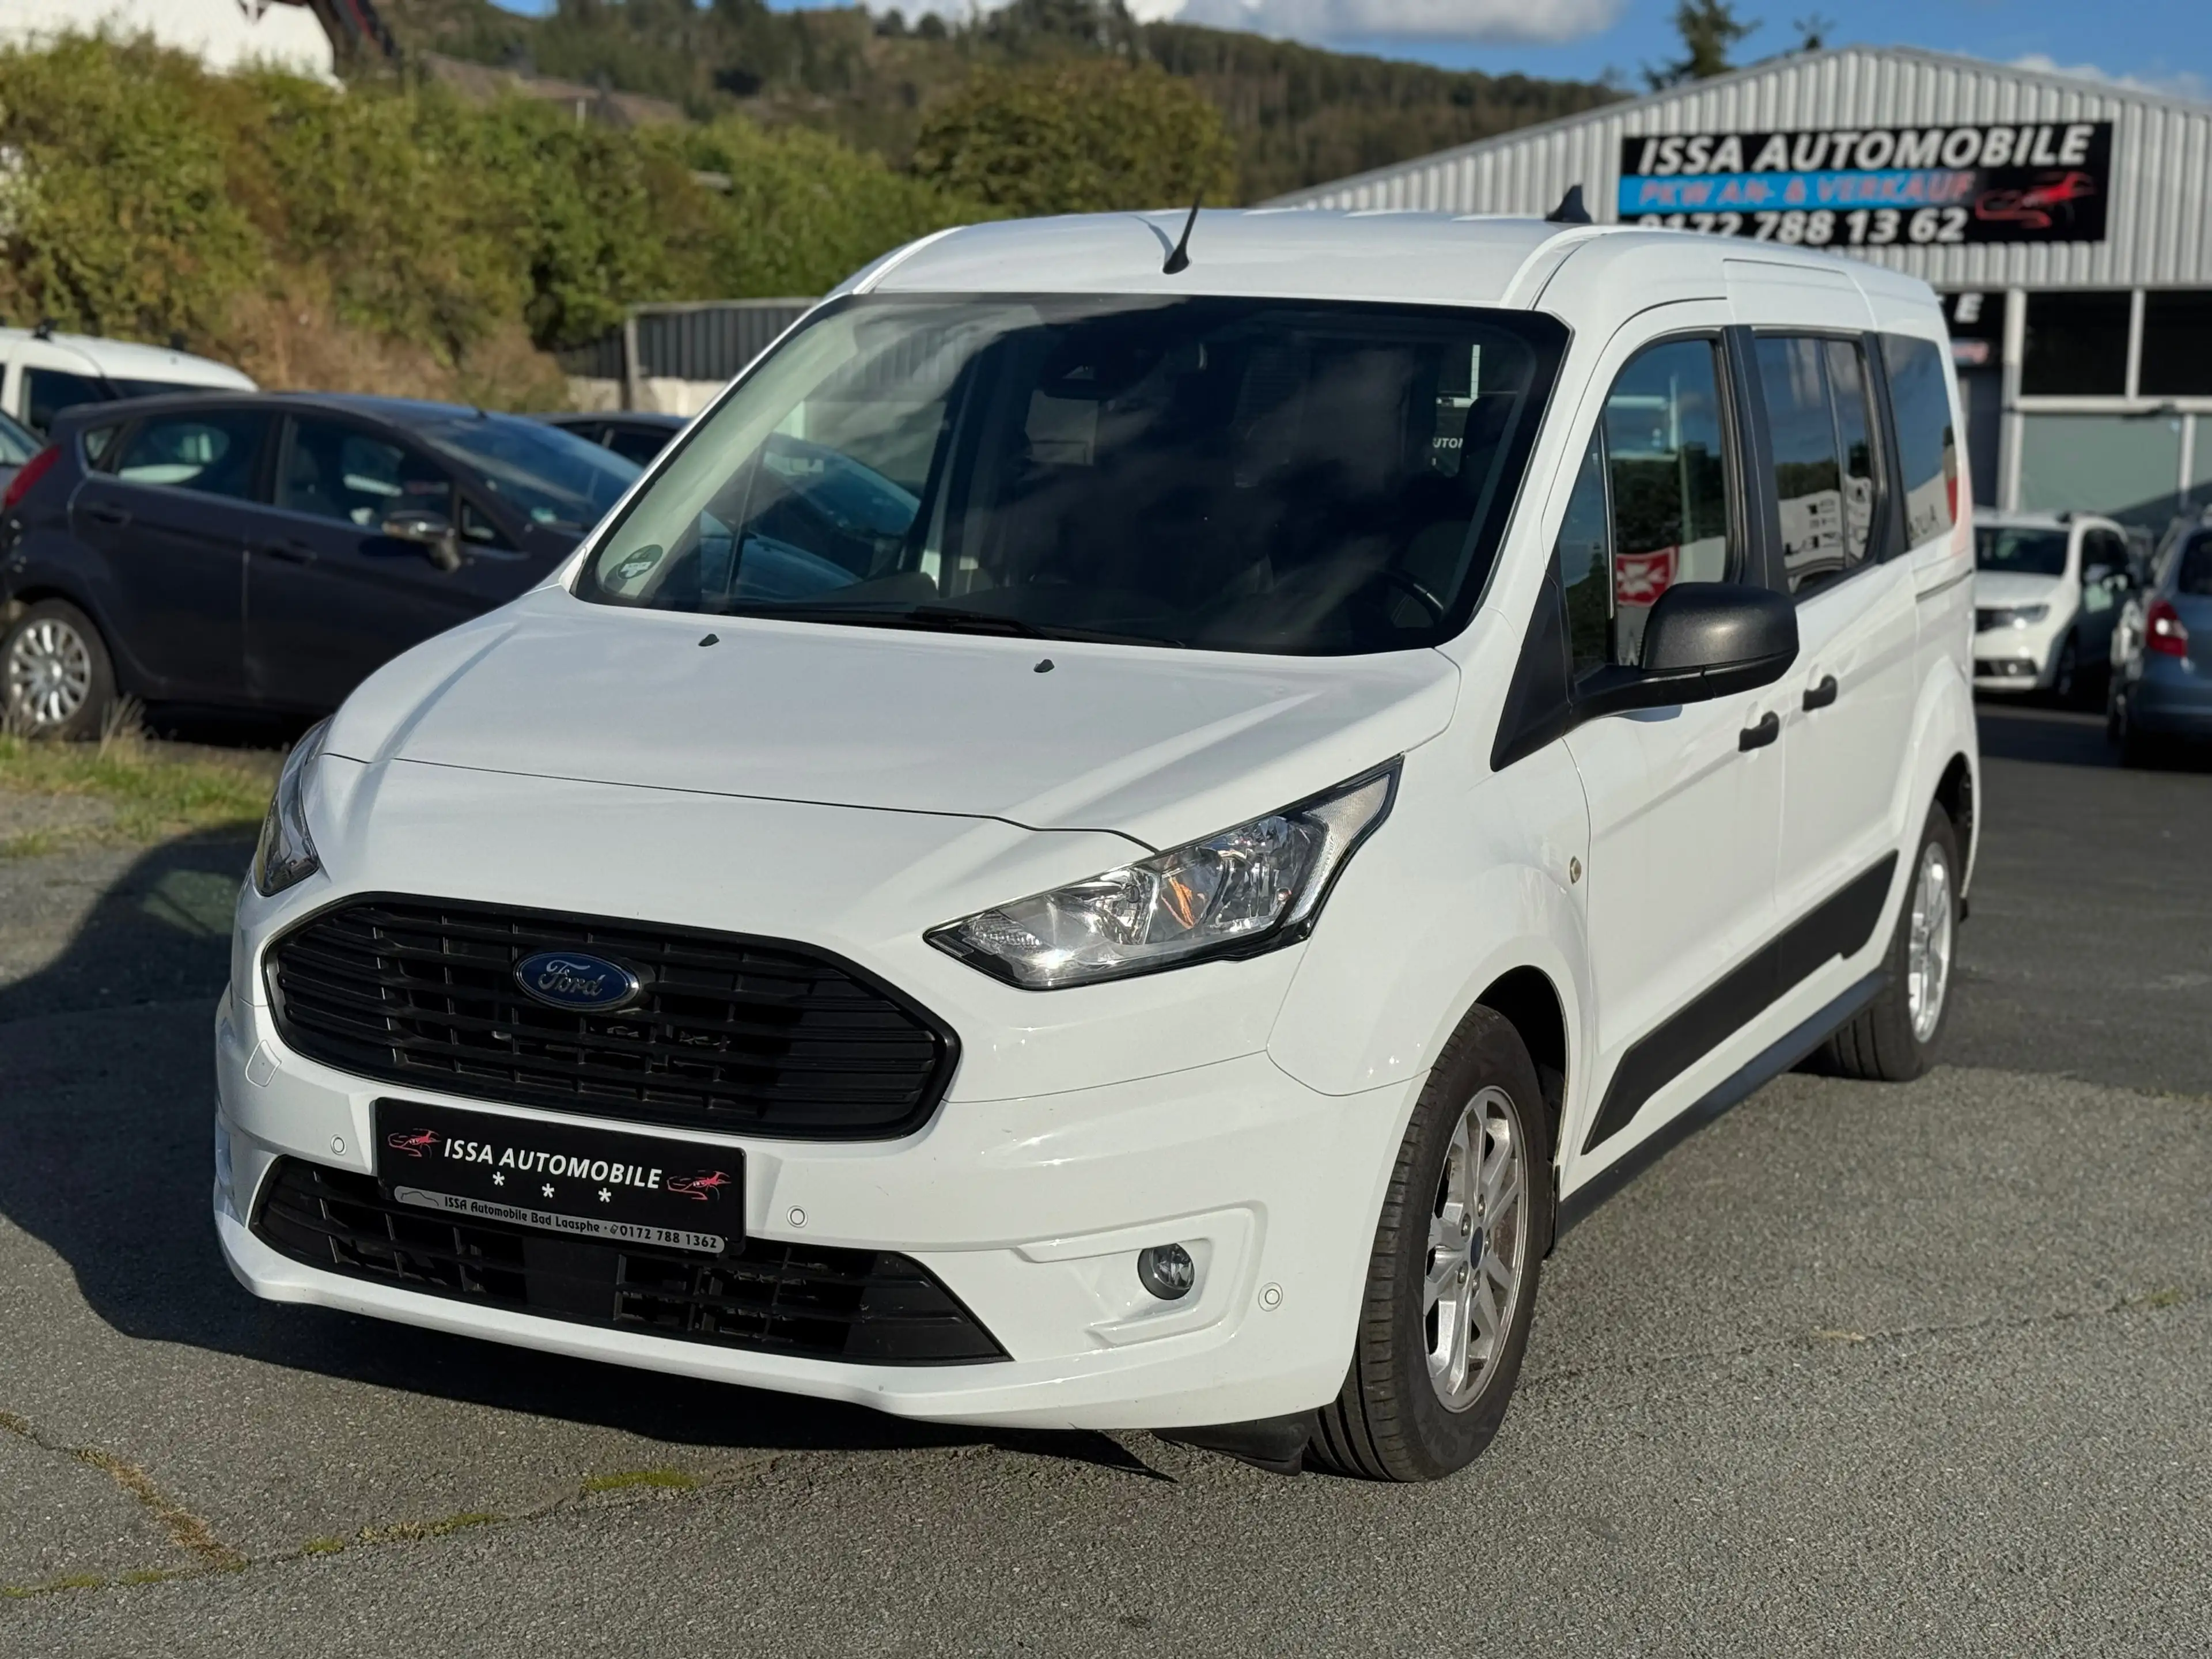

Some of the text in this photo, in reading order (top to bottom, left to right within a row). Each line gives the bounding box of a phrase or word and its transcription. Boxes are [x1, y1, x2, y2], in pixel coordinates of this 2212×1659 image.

[1638, 125, 2092, 176] ISSA AUTOMOBILE
[1639, 180, 1714, 206] PKW
[1817, 171, 1975, 202] VERKAUF
[1753, 210, 1836, 244] 788
[1846, 209, 1900, 244] 13
[1908, 206, 1969, 243] 62
[538, 960, 606, 997] Ford
[444, 1138, 662, 1189] ISSA AUTOMOBILE
[445, 1196, 717, 1249] ISSA Automobile Bad Laasphe 0172 788 1362
